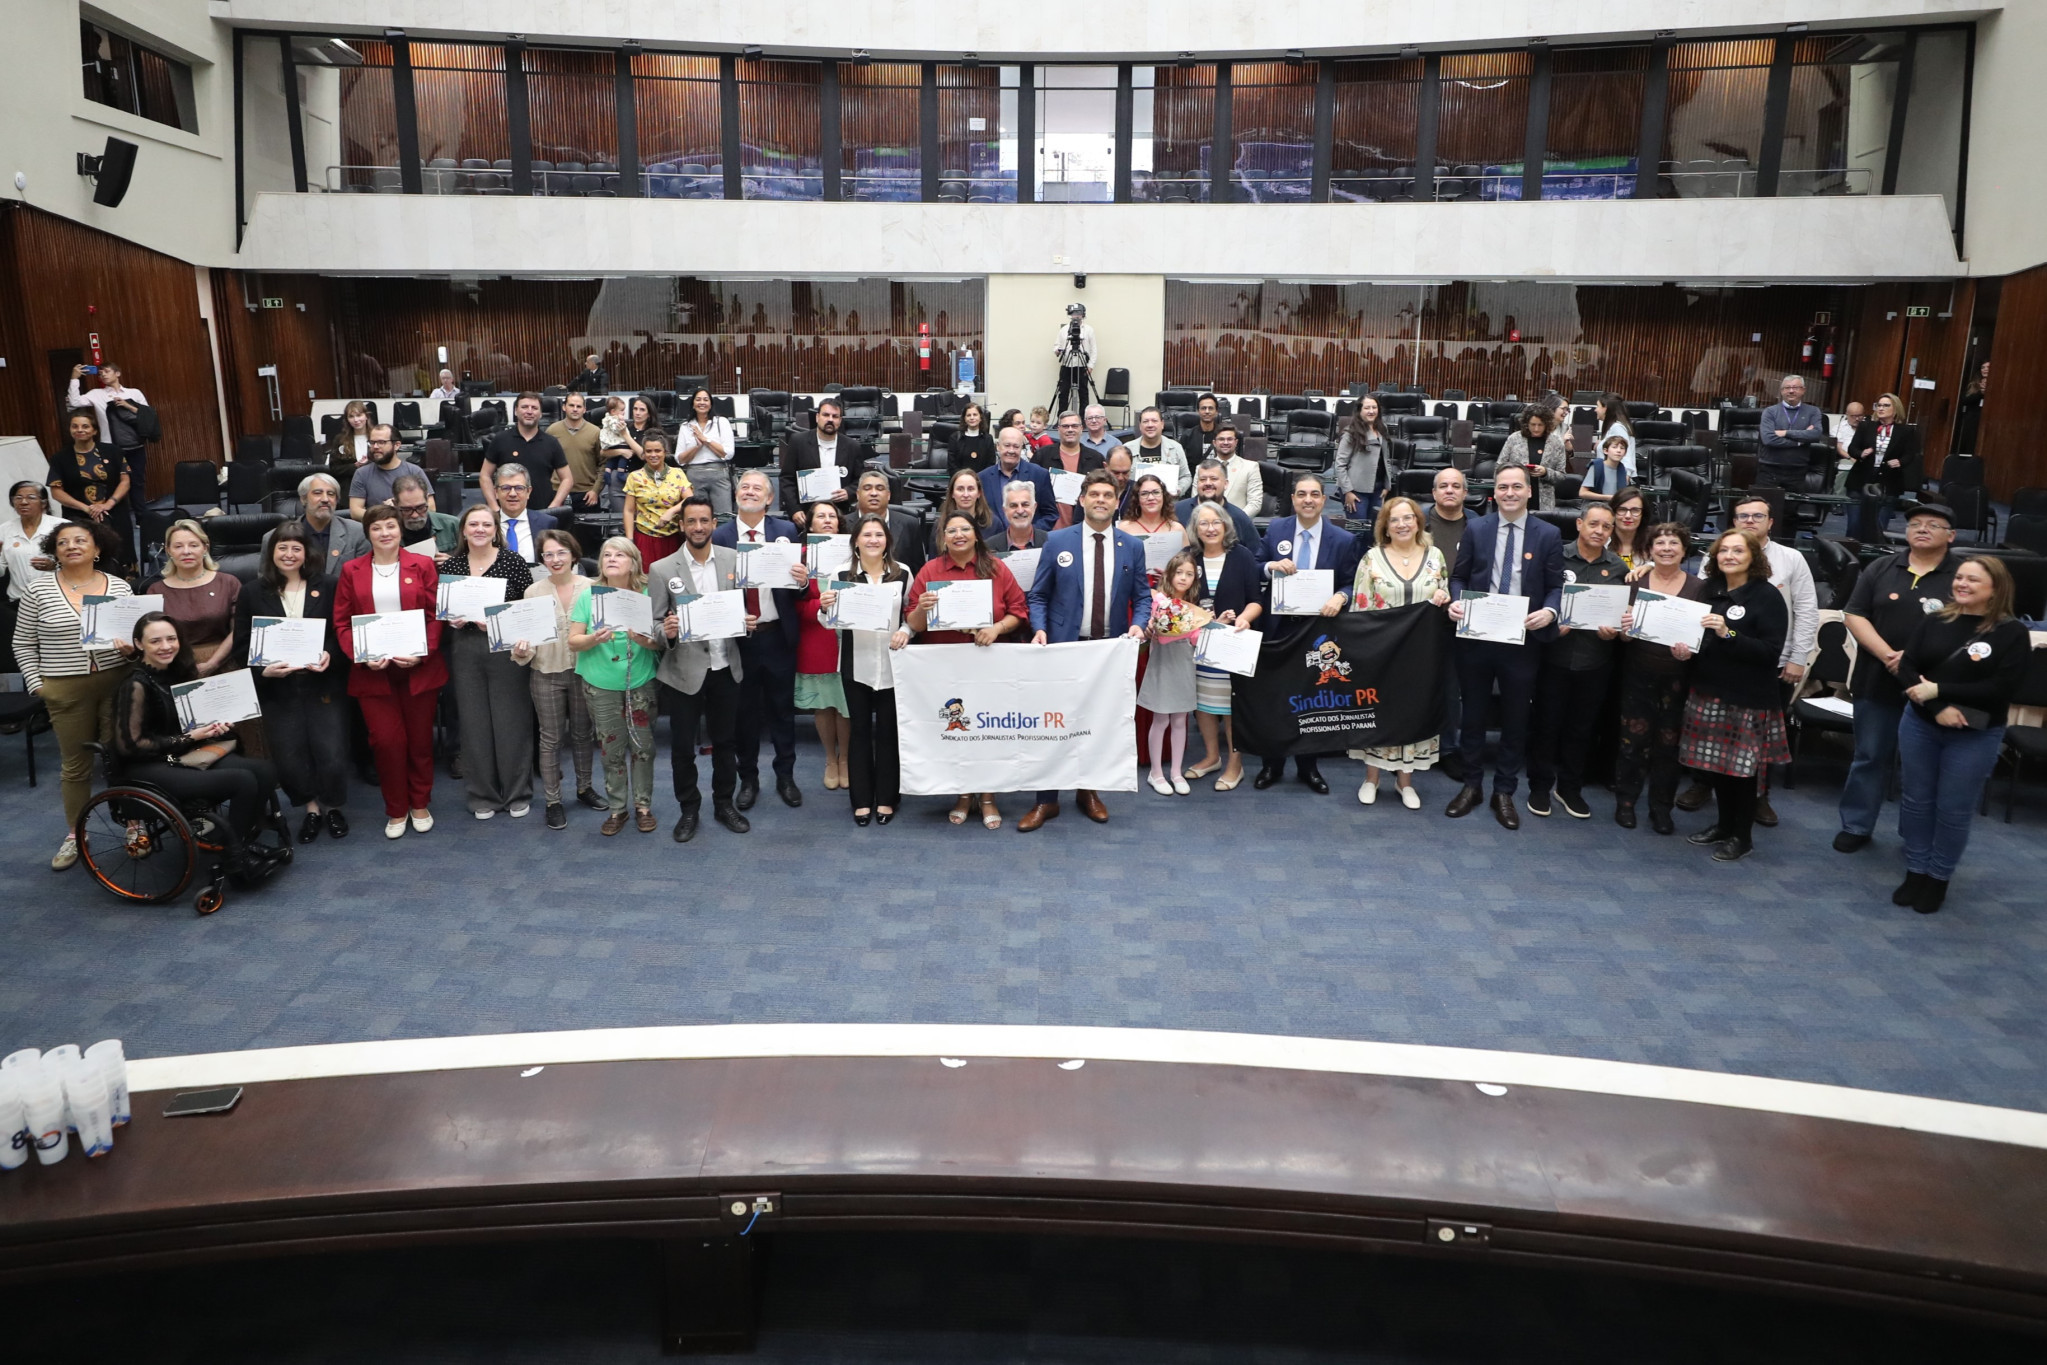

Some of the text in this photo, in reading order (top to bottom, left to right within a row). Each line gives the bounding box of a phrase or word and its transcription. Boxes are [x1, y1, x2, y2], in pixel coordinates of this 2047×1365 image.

[1289, 688, 1380, 713] SindiJor PR
[976, 711, 1065, 729] SindiJor PR
[1327, 715, 1340, 723] DOS
[1299, 724, 1341, 735] PROFISSIONAIS
[1351, 721, 1377, 730] PARANÁ
